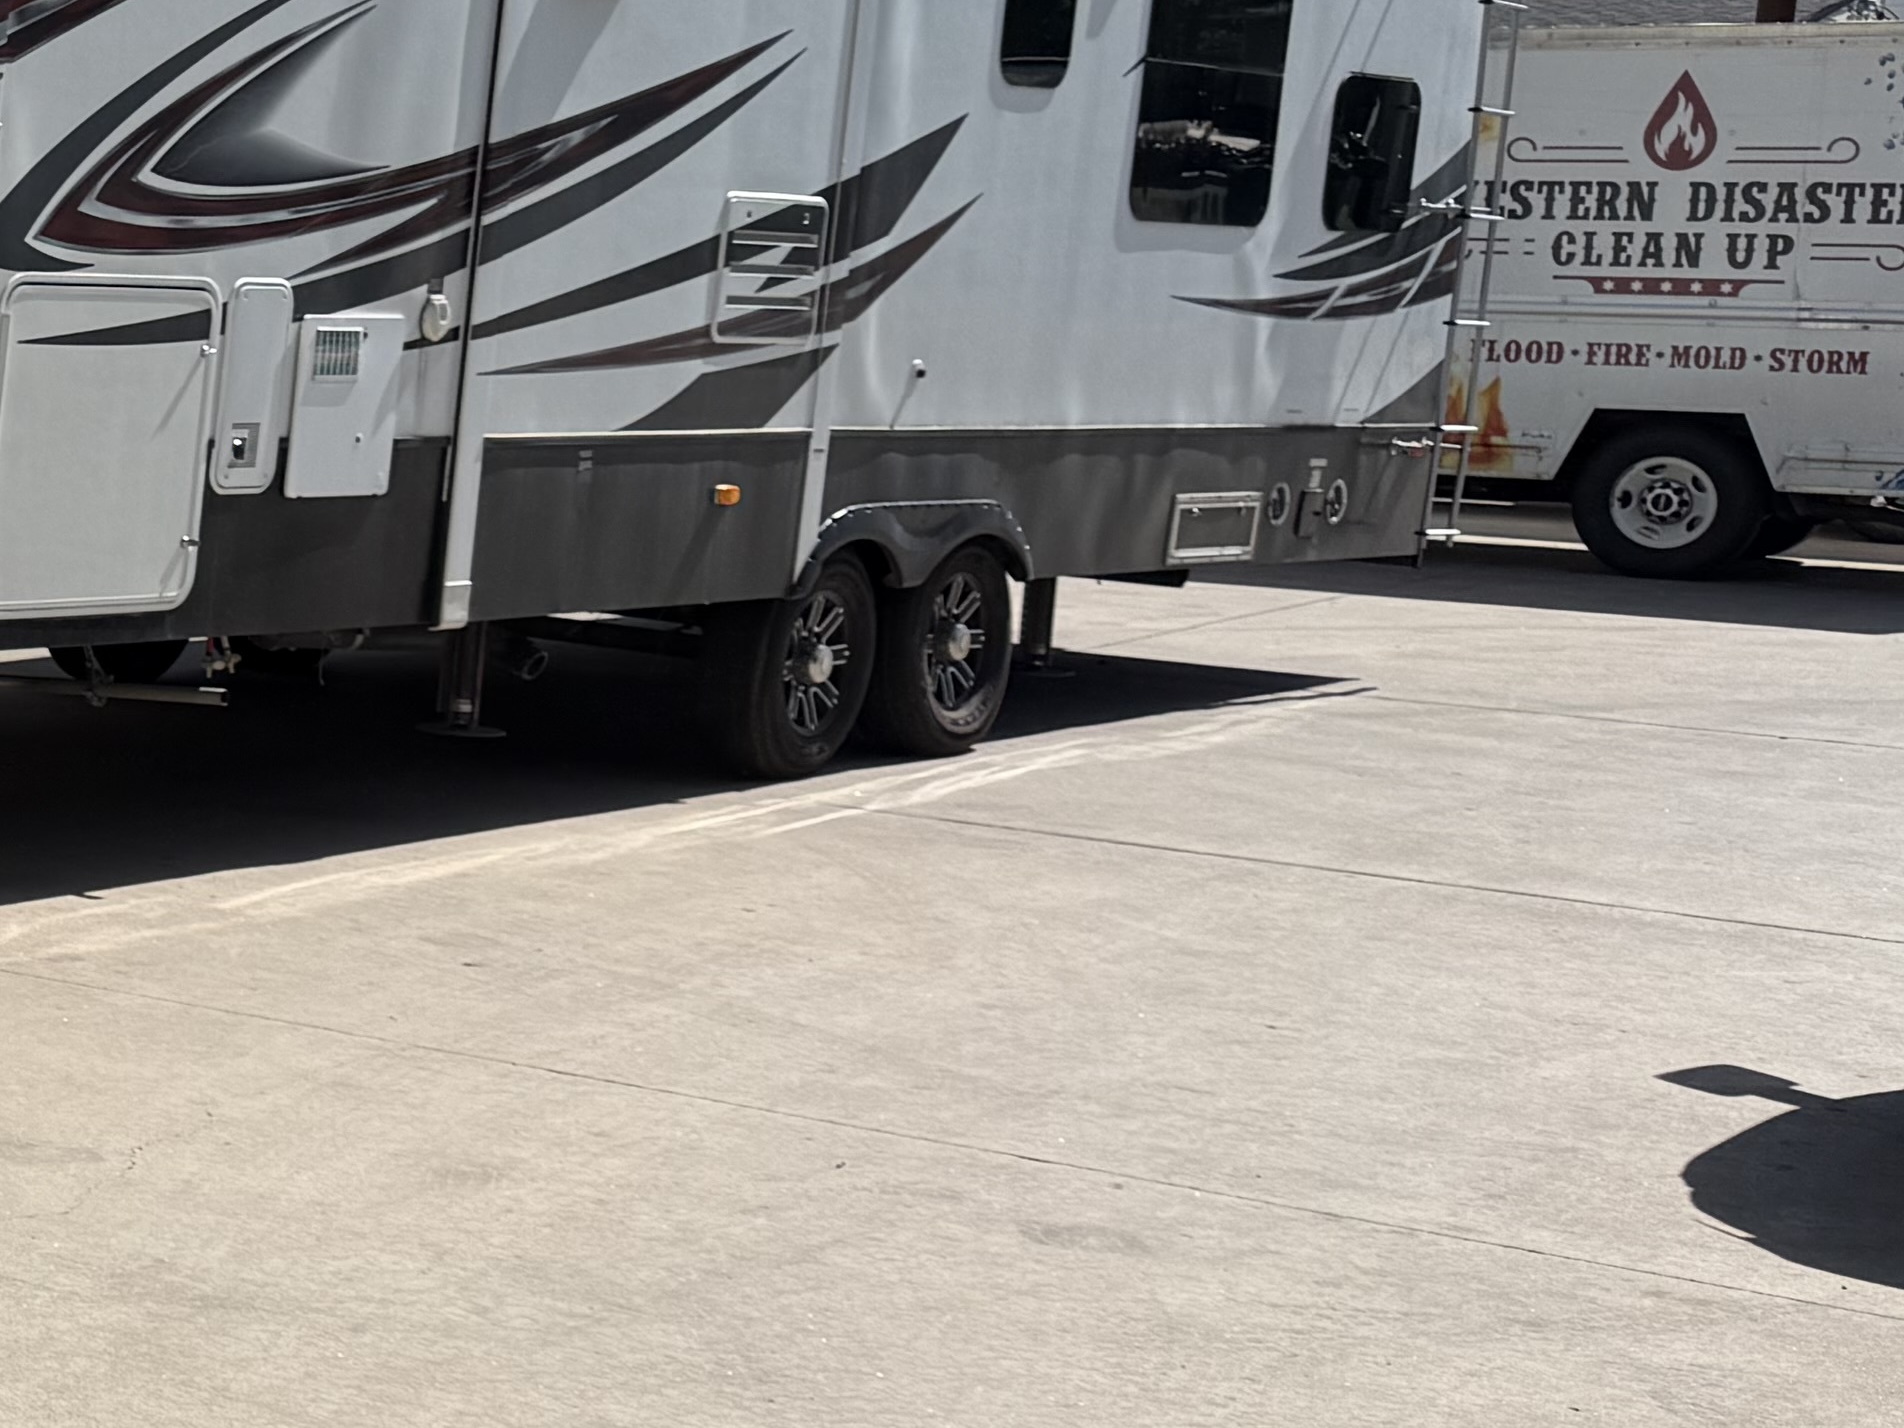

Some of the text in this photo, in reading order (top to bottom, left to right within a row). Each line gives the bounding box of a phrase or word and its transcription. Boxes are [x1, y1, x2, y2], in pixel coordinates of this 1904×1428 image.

[1472, 179, 1904, 225] ESTERN DISASTE
[1552, 230, 1796, 271] CLEAN UP
[1584, 341, 1652, 368] FIRE
[1669, 344, 1747, 371] MOLD
[1768, 347, 1870, 376] STORM
